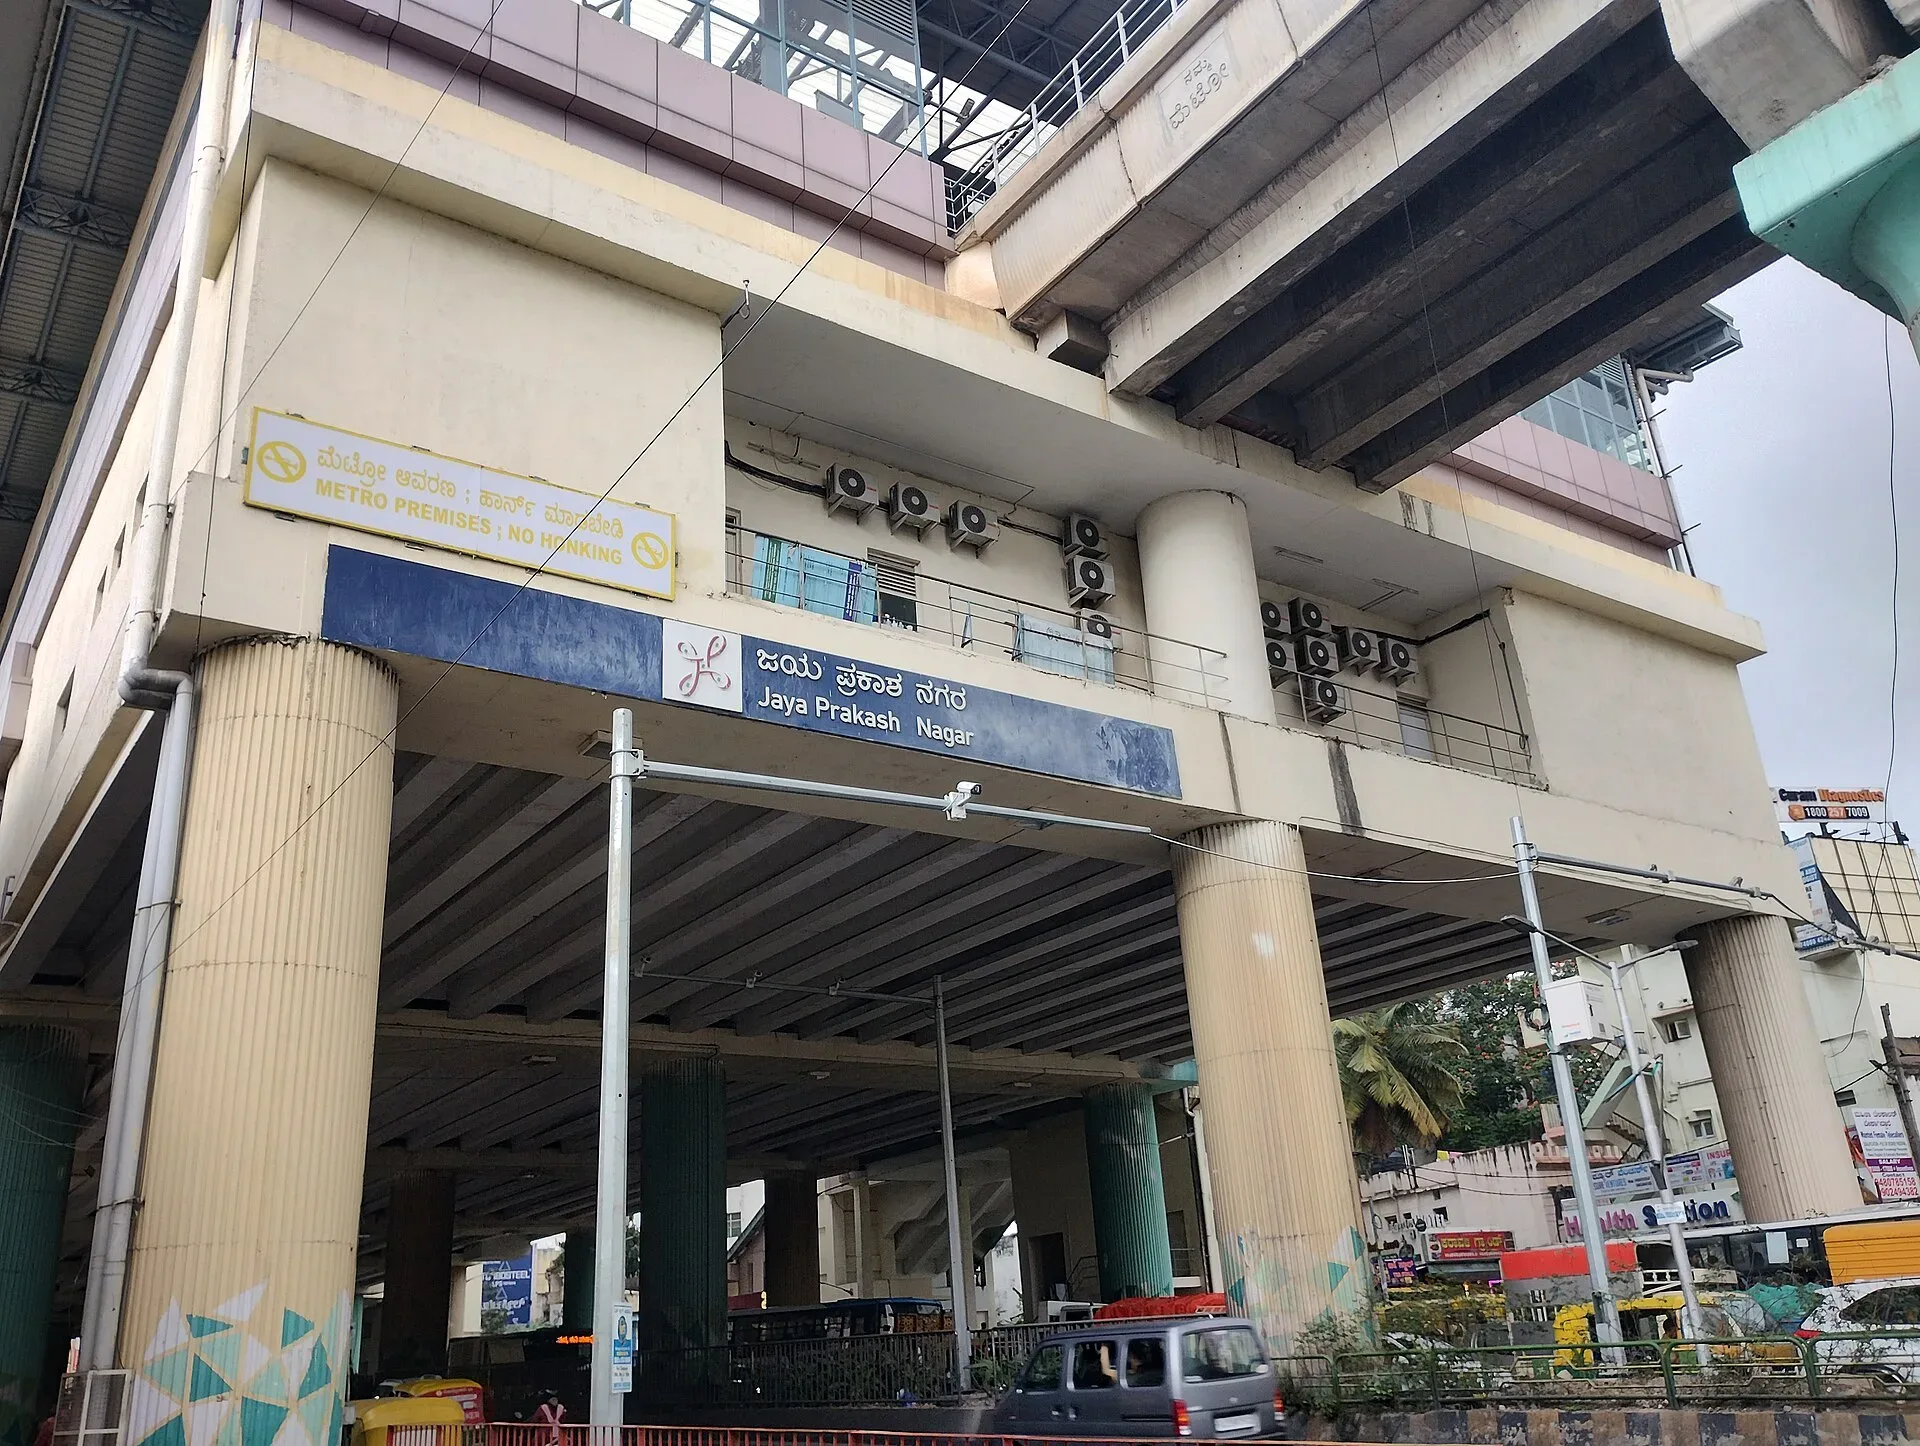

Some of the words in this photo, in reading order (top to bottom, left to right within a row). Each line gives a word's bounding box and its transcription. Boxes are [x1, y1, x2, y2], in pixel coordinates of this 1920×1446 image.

[316, 479, 387, 509] METRO
[395, 497, 491, 535] PREMISES
[508, 524, 534, 544] NO
[541, 532, 622, 565] HONKING
[317, 446, 386, 487] ಮೆಟ್ರೋ
[396, 469, 456, 498] ಆವರಣ
[480, 489, 536, 517] ಹಾರ್ನ್
[545, 502, 624, 539] ಮಾಡಬೇಡಿ
[757, 648, 822, 681] ಜಯ
[836, 663, 903, 697] ಪ್ರಕಾಶ
[916, 680, 967, 711] ನಗರ
[758, 687, 808, 717] Jaya
[815, 696, 901, 732] Prakash
[917, 716, 974, 748] Nagar
[1805, 807, 1827, 817] 1800
[1828, 807, 1845, 817] 257
[1846, 807, 1869, 817] 7009
[1564, 1209, 1638, 1236] Hlth
[1642, 1199, 1730, 1227] Stion
